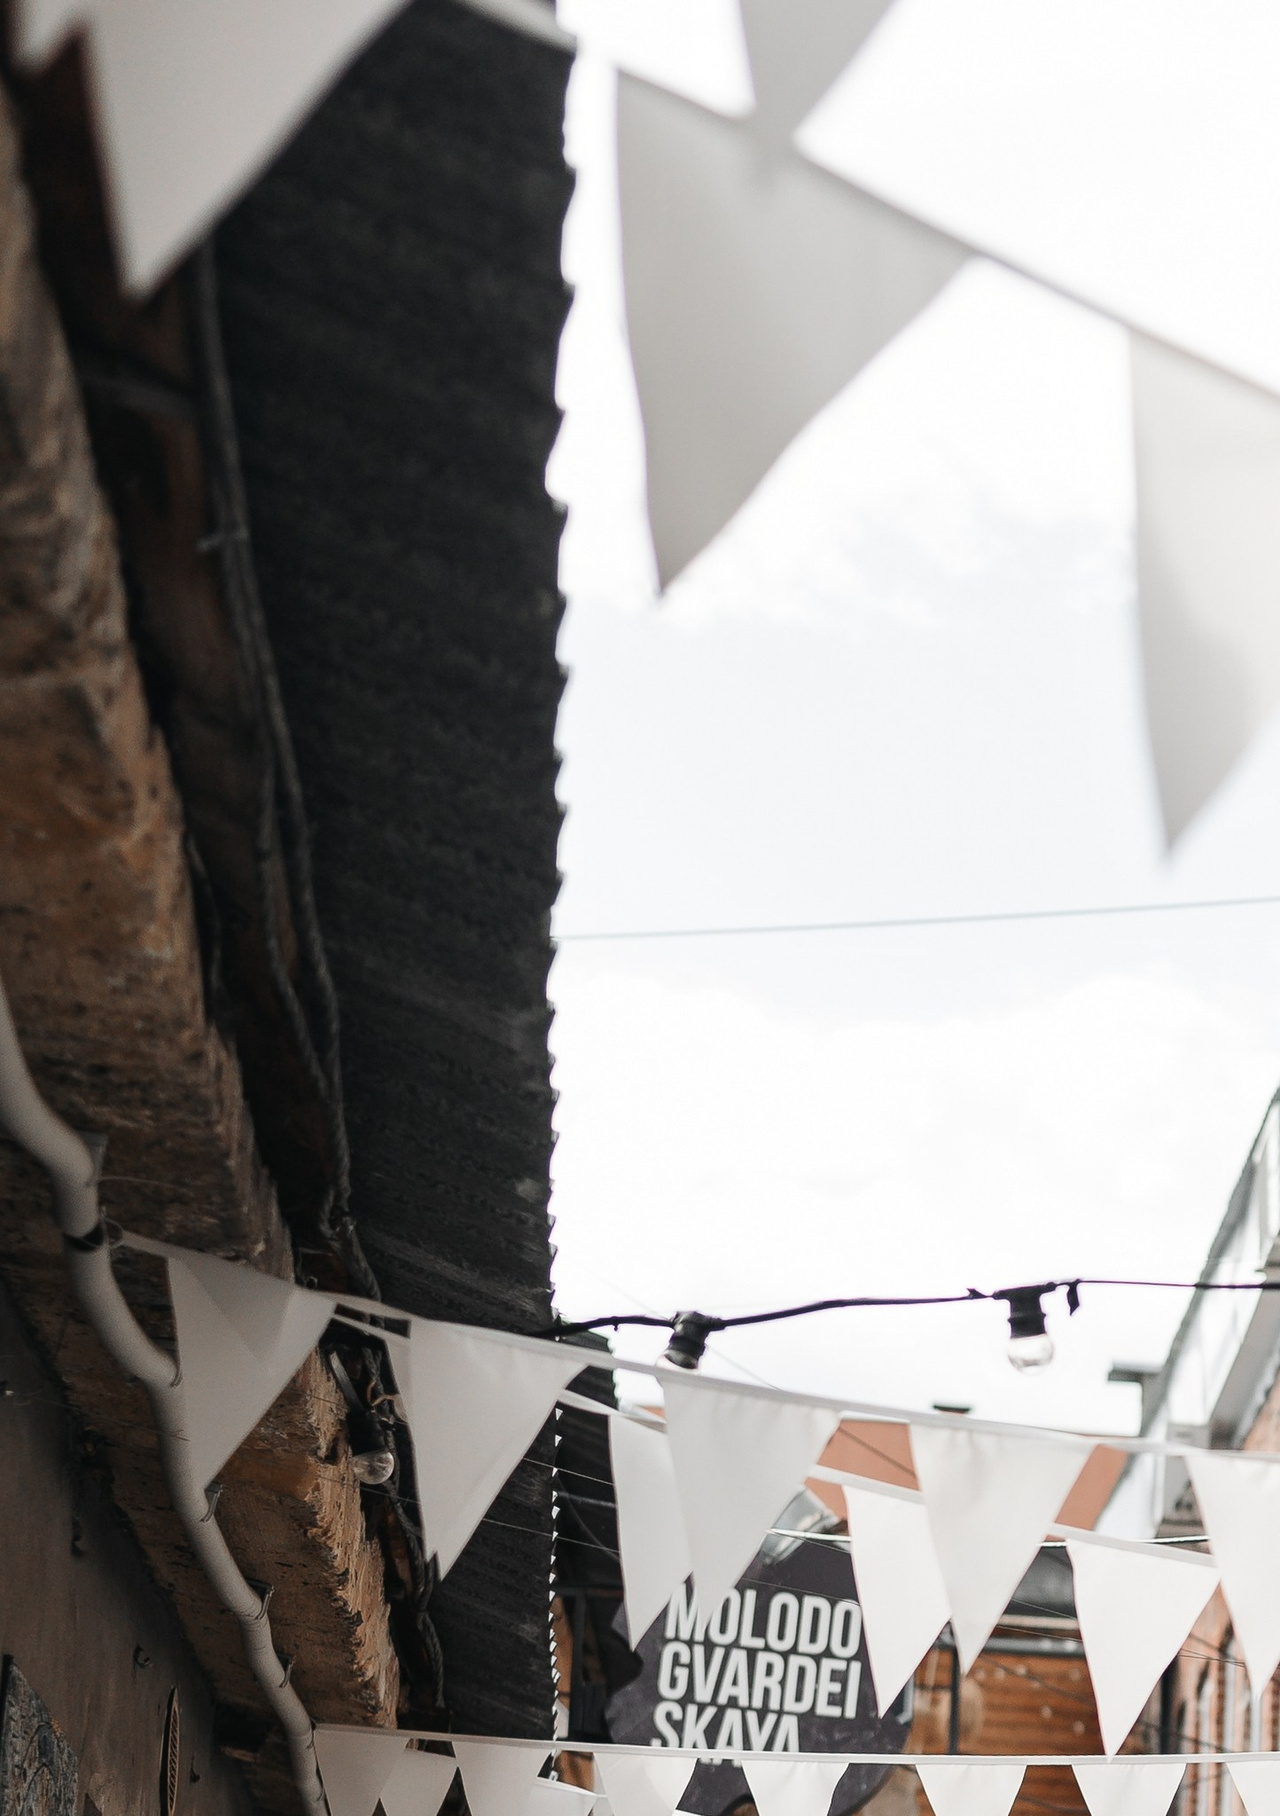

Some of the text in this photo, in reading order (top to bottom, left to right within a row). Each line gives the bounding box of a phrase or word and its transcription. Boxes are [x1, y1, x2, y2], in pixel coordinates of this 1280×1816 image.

[665, 1582, 862, 1658] MOLODO
[657, 1640, 862, 1719] GVARDEI
[651, 1701, 800, 1766] SKAYA
